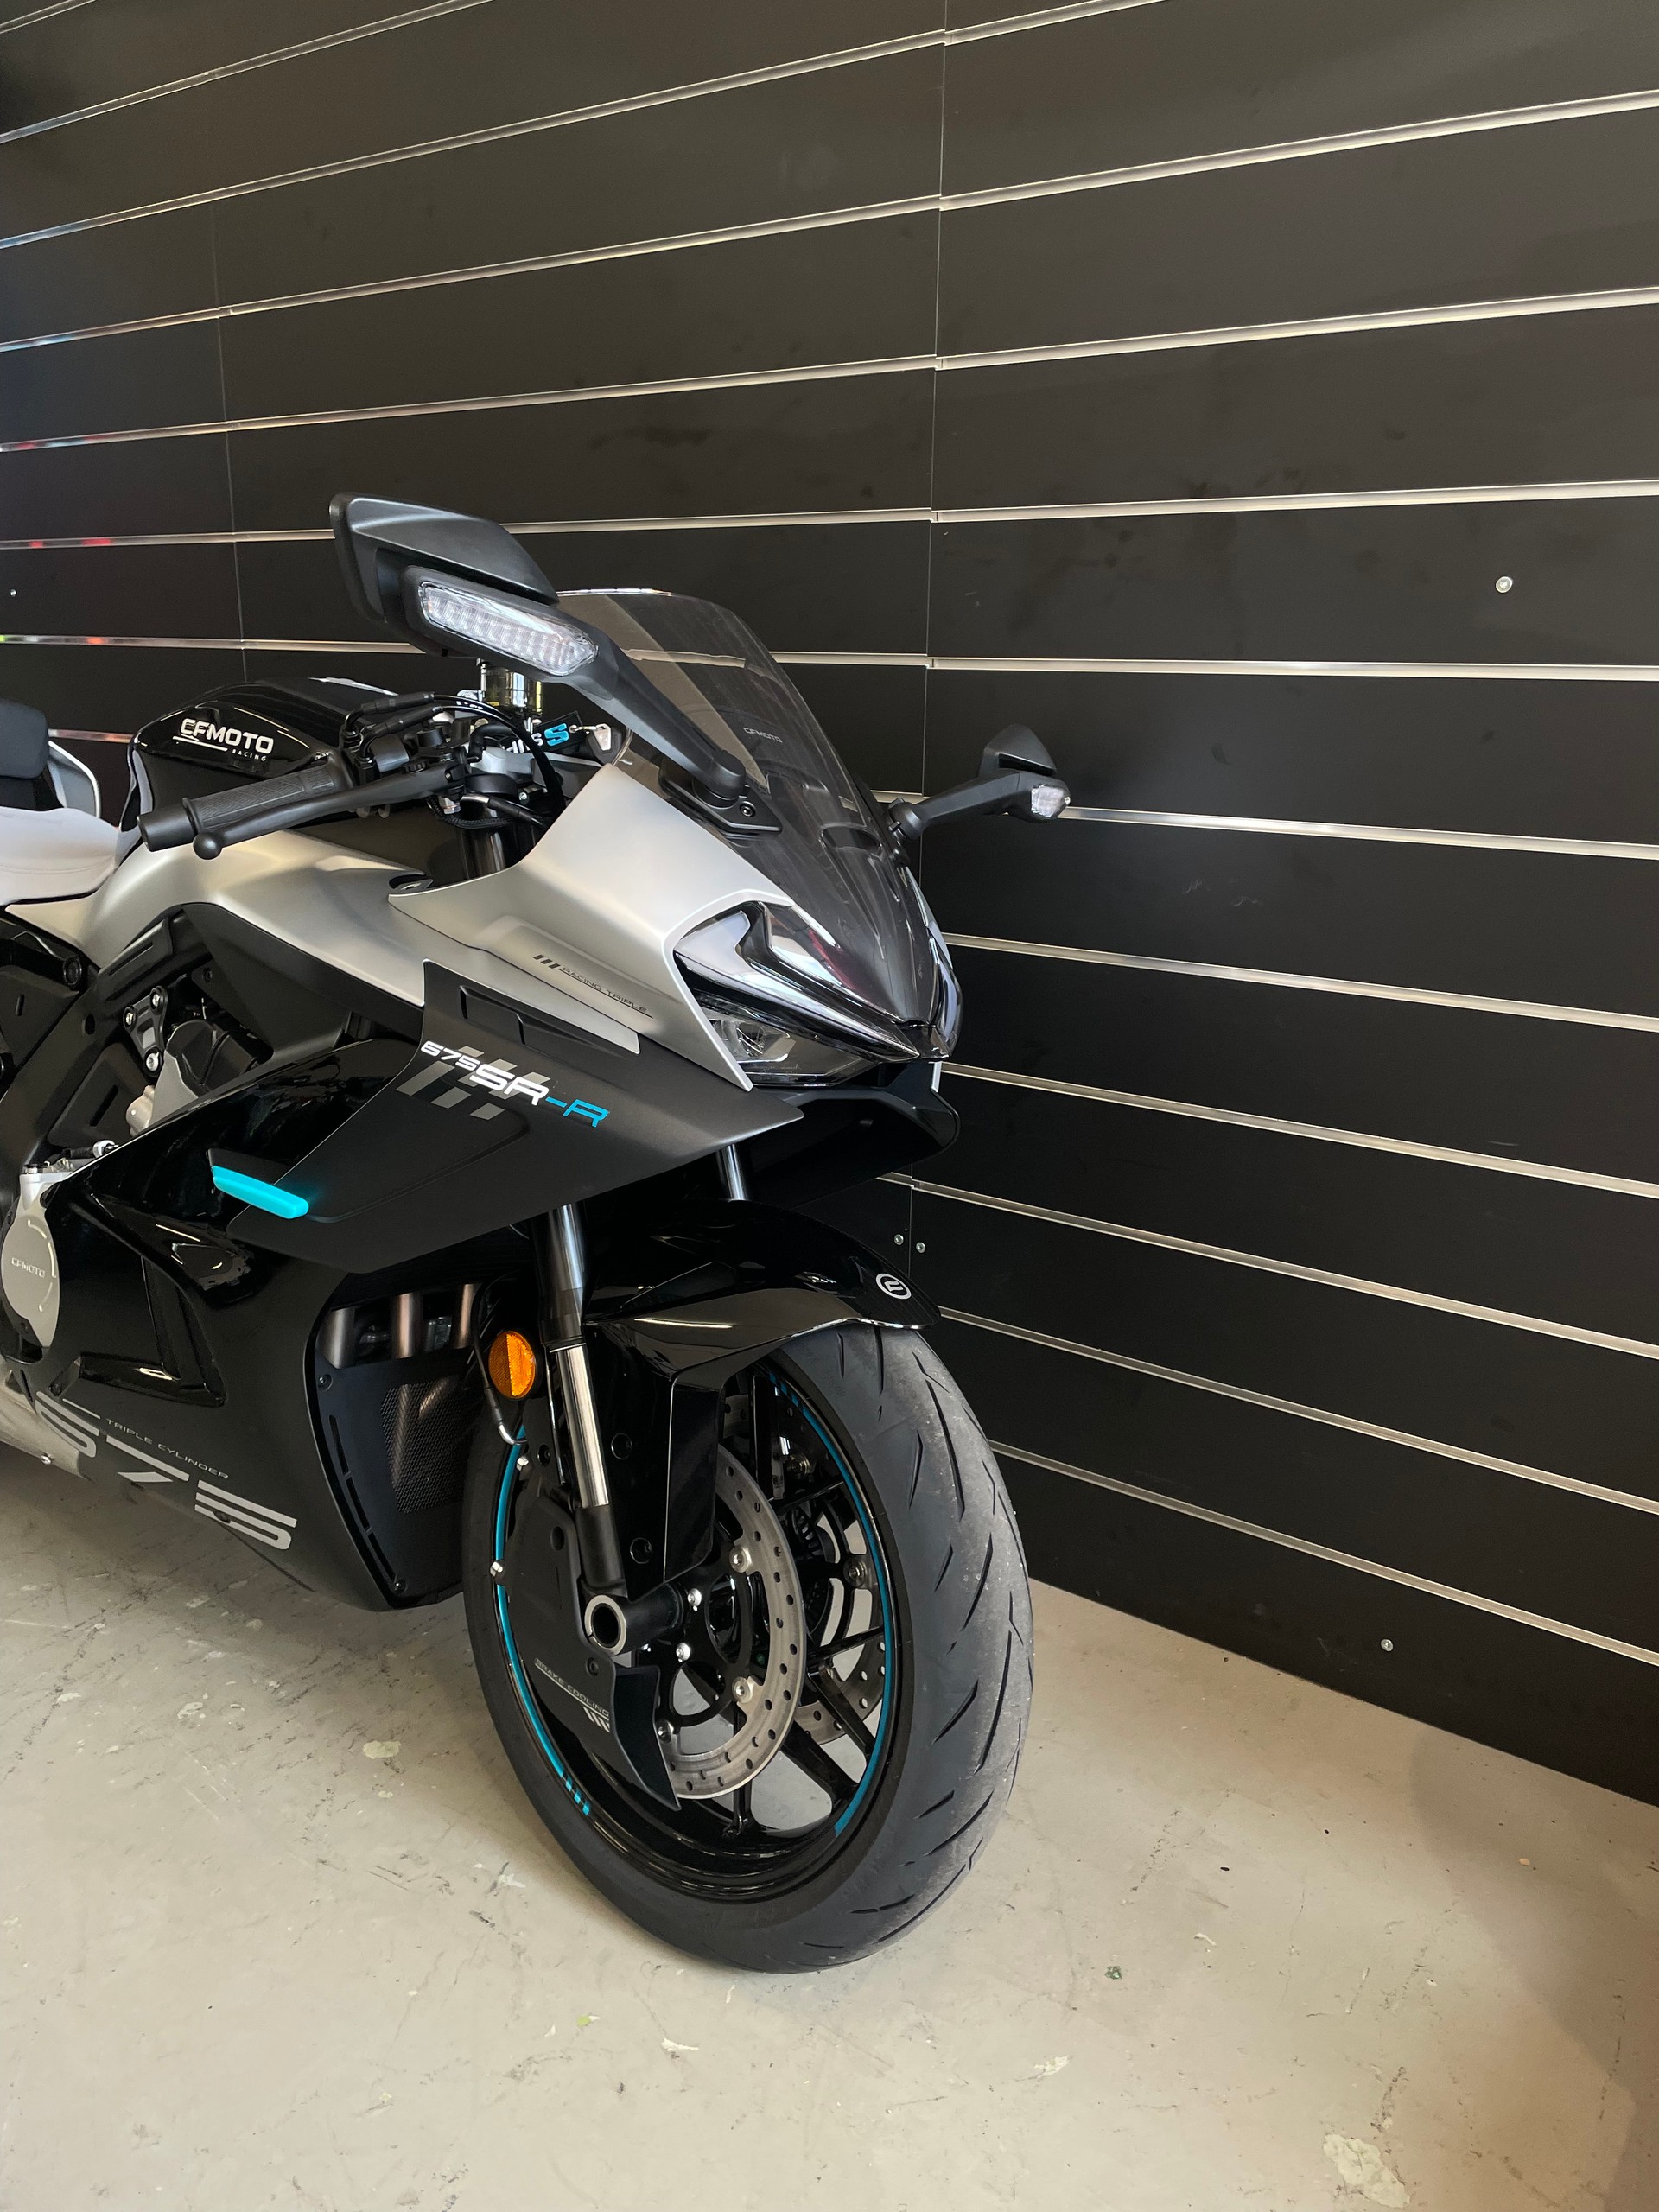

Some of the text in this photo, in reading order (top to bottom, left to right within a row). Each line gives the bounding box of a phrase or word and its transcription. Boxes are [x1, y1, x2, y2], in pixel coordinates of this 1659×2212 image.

[180, 718, 274, 754] CFMOTO
[232, 749, 267, 761] RACING
[563, 967, 647, 1014] RACING TRIPLE
[106, 1418, 229, 1479] TRIPLE CYLINDER
[536, 1658, 609, 1717] BRAKE COOLING
